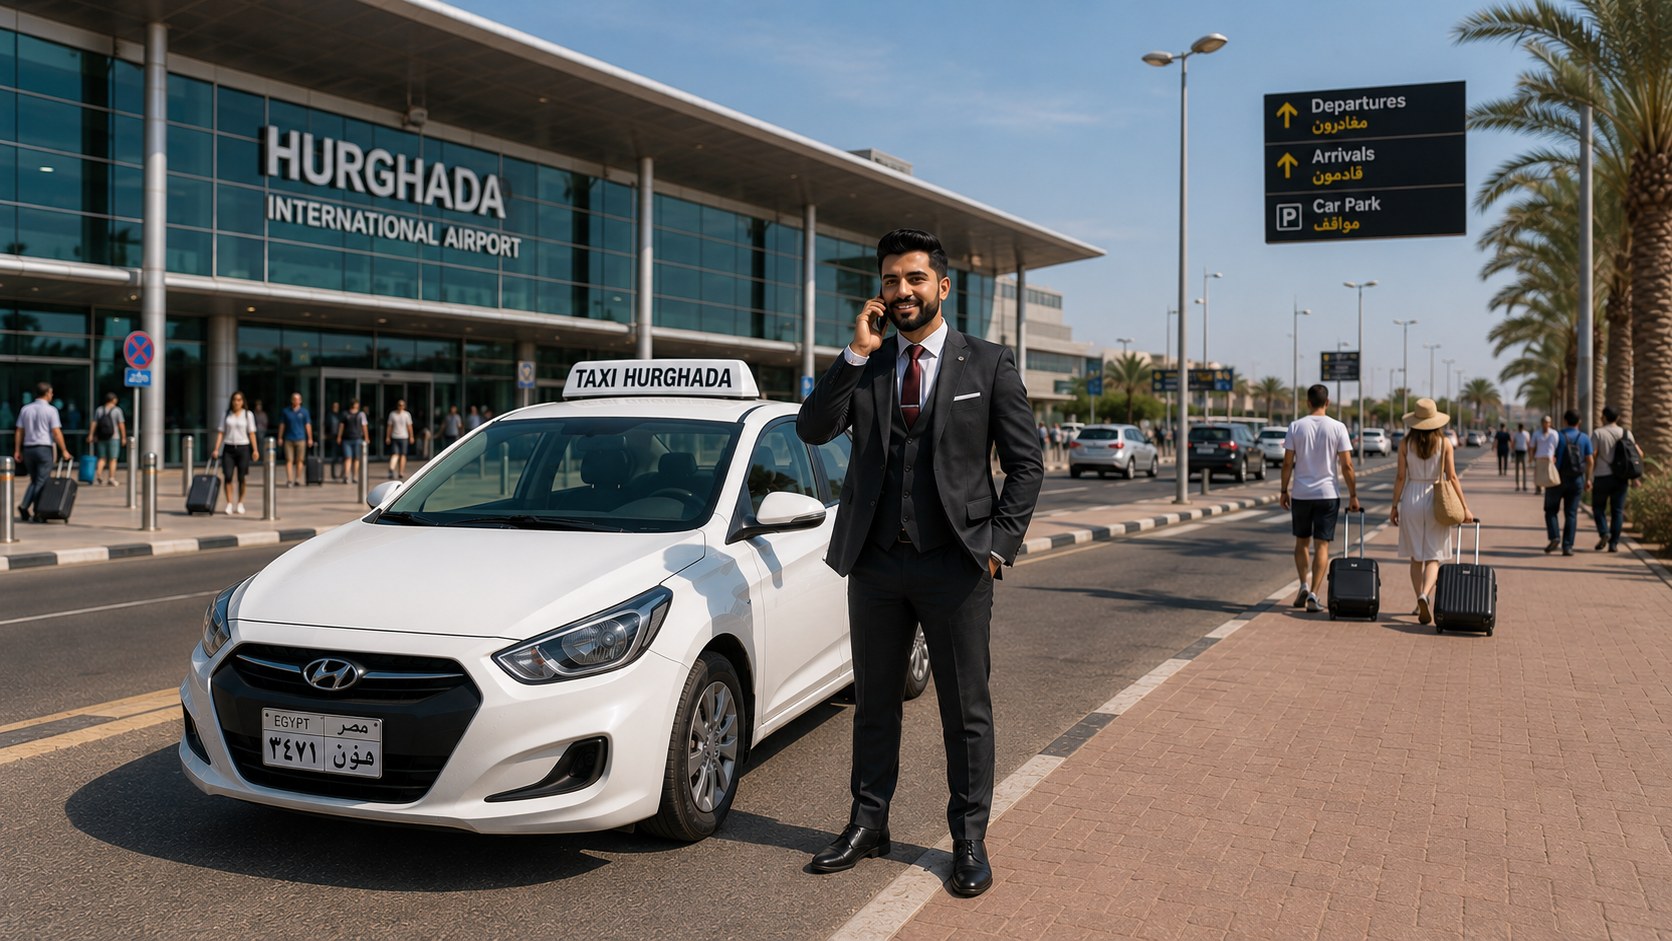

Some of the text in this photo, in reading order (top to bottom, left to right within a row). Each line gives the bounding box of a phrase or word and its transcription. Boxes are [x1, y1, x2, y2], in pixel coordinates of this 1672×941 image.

[1311, 96, 1406, 115] Departures
[1311, 116, 1368, 134] مغادرون
[1312, 146, 1375, 164] Arrivals
[267, 125, 506, 219] HURGHADA
[1312, 166, 1363, 185] قادمون
[1313, 196, 1381, 213] Car Park
[268, 194, 521, 258] INTERNATIONAL AIRPORT
[1313, 216, 1360, 233] مواقف
[576, 367, 732, 388] TAXI HURGHADA
[274, 715, 310, 730] EGYPT
[337, 722, 368, 735] مصر
[269, 736, 316, 764] ٣٤٧١
